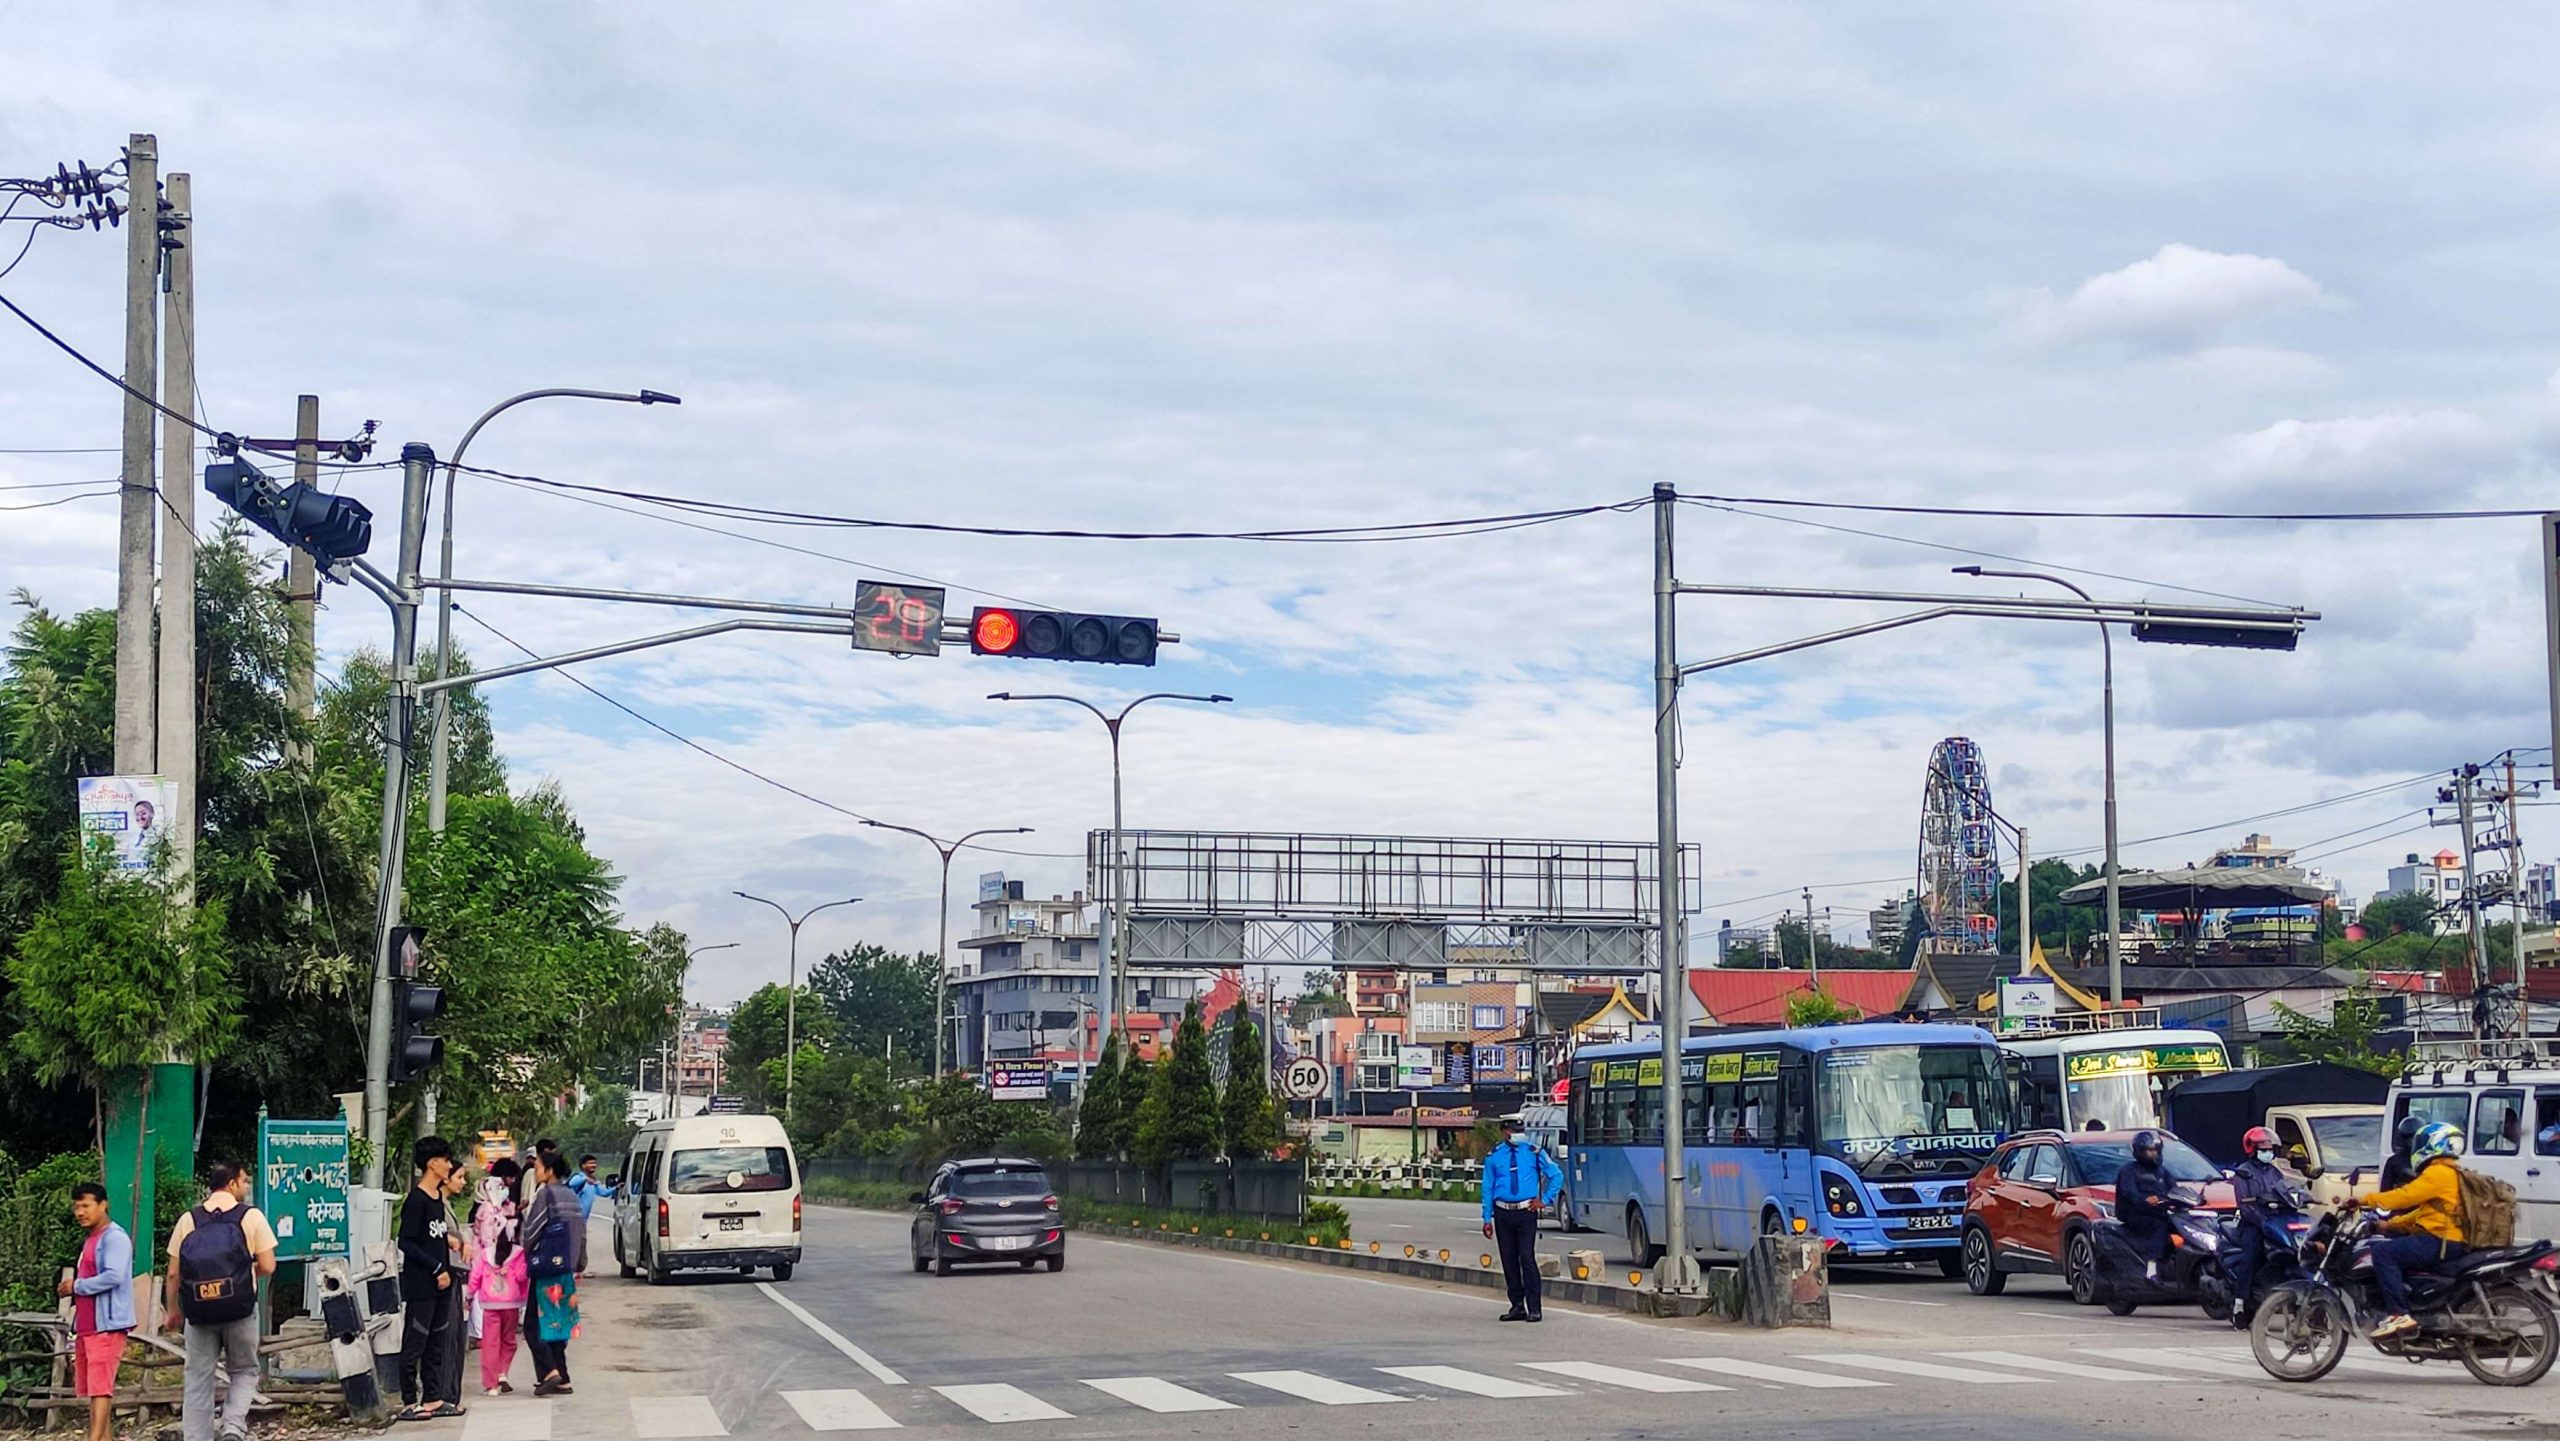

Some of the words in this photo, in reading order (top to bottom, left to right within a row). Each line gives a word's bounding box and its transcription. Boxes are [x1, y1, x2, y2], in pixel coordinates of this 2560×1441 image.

[1292, 1067, 1319, 1087] 50
[1905, 1134, 1997, 1150] यातायात
[1913, 1161, 1937, 1169] TATA
[200, 1282, 223, 1299] CAT
